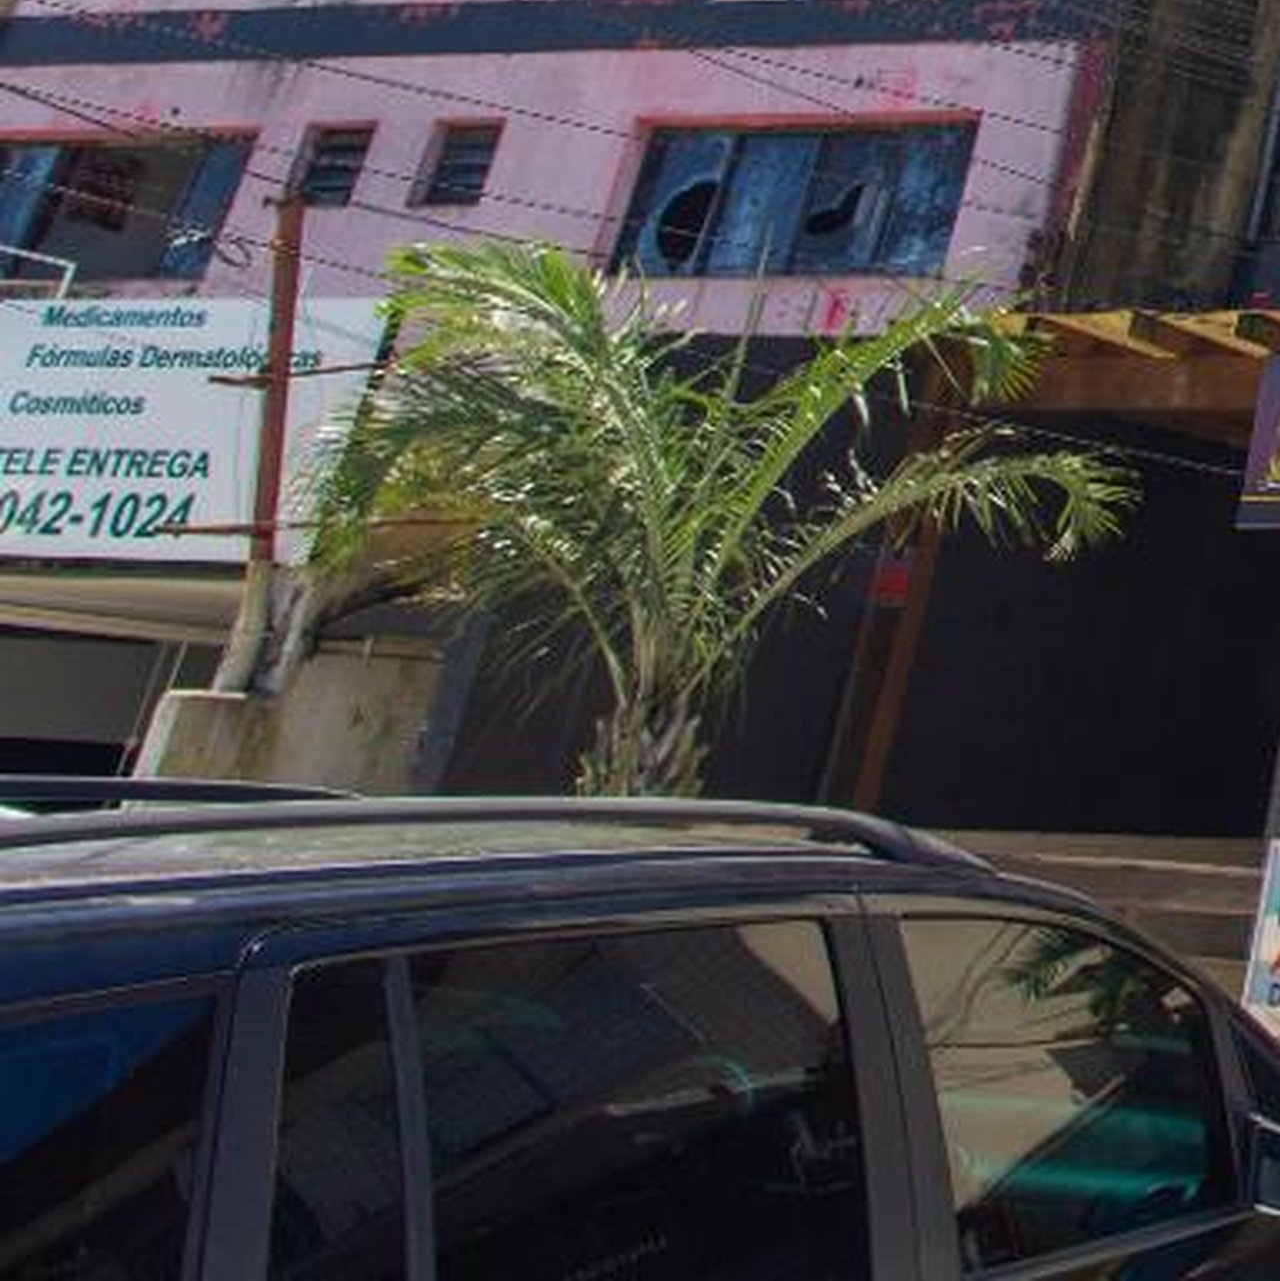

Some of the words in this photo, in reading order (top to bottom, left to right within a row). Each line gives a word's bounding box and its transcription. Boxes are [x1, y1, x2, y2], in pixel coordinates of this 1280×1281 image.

[40, 305, 209, 330] Medicamentos
[25, 341, 135, 370] Fórmulas
[138, 341, 323, 370] Dermatolóas
[8, 389, 147, 418] Cosméticos
[65, 447, 211, 479] ENTREGA
